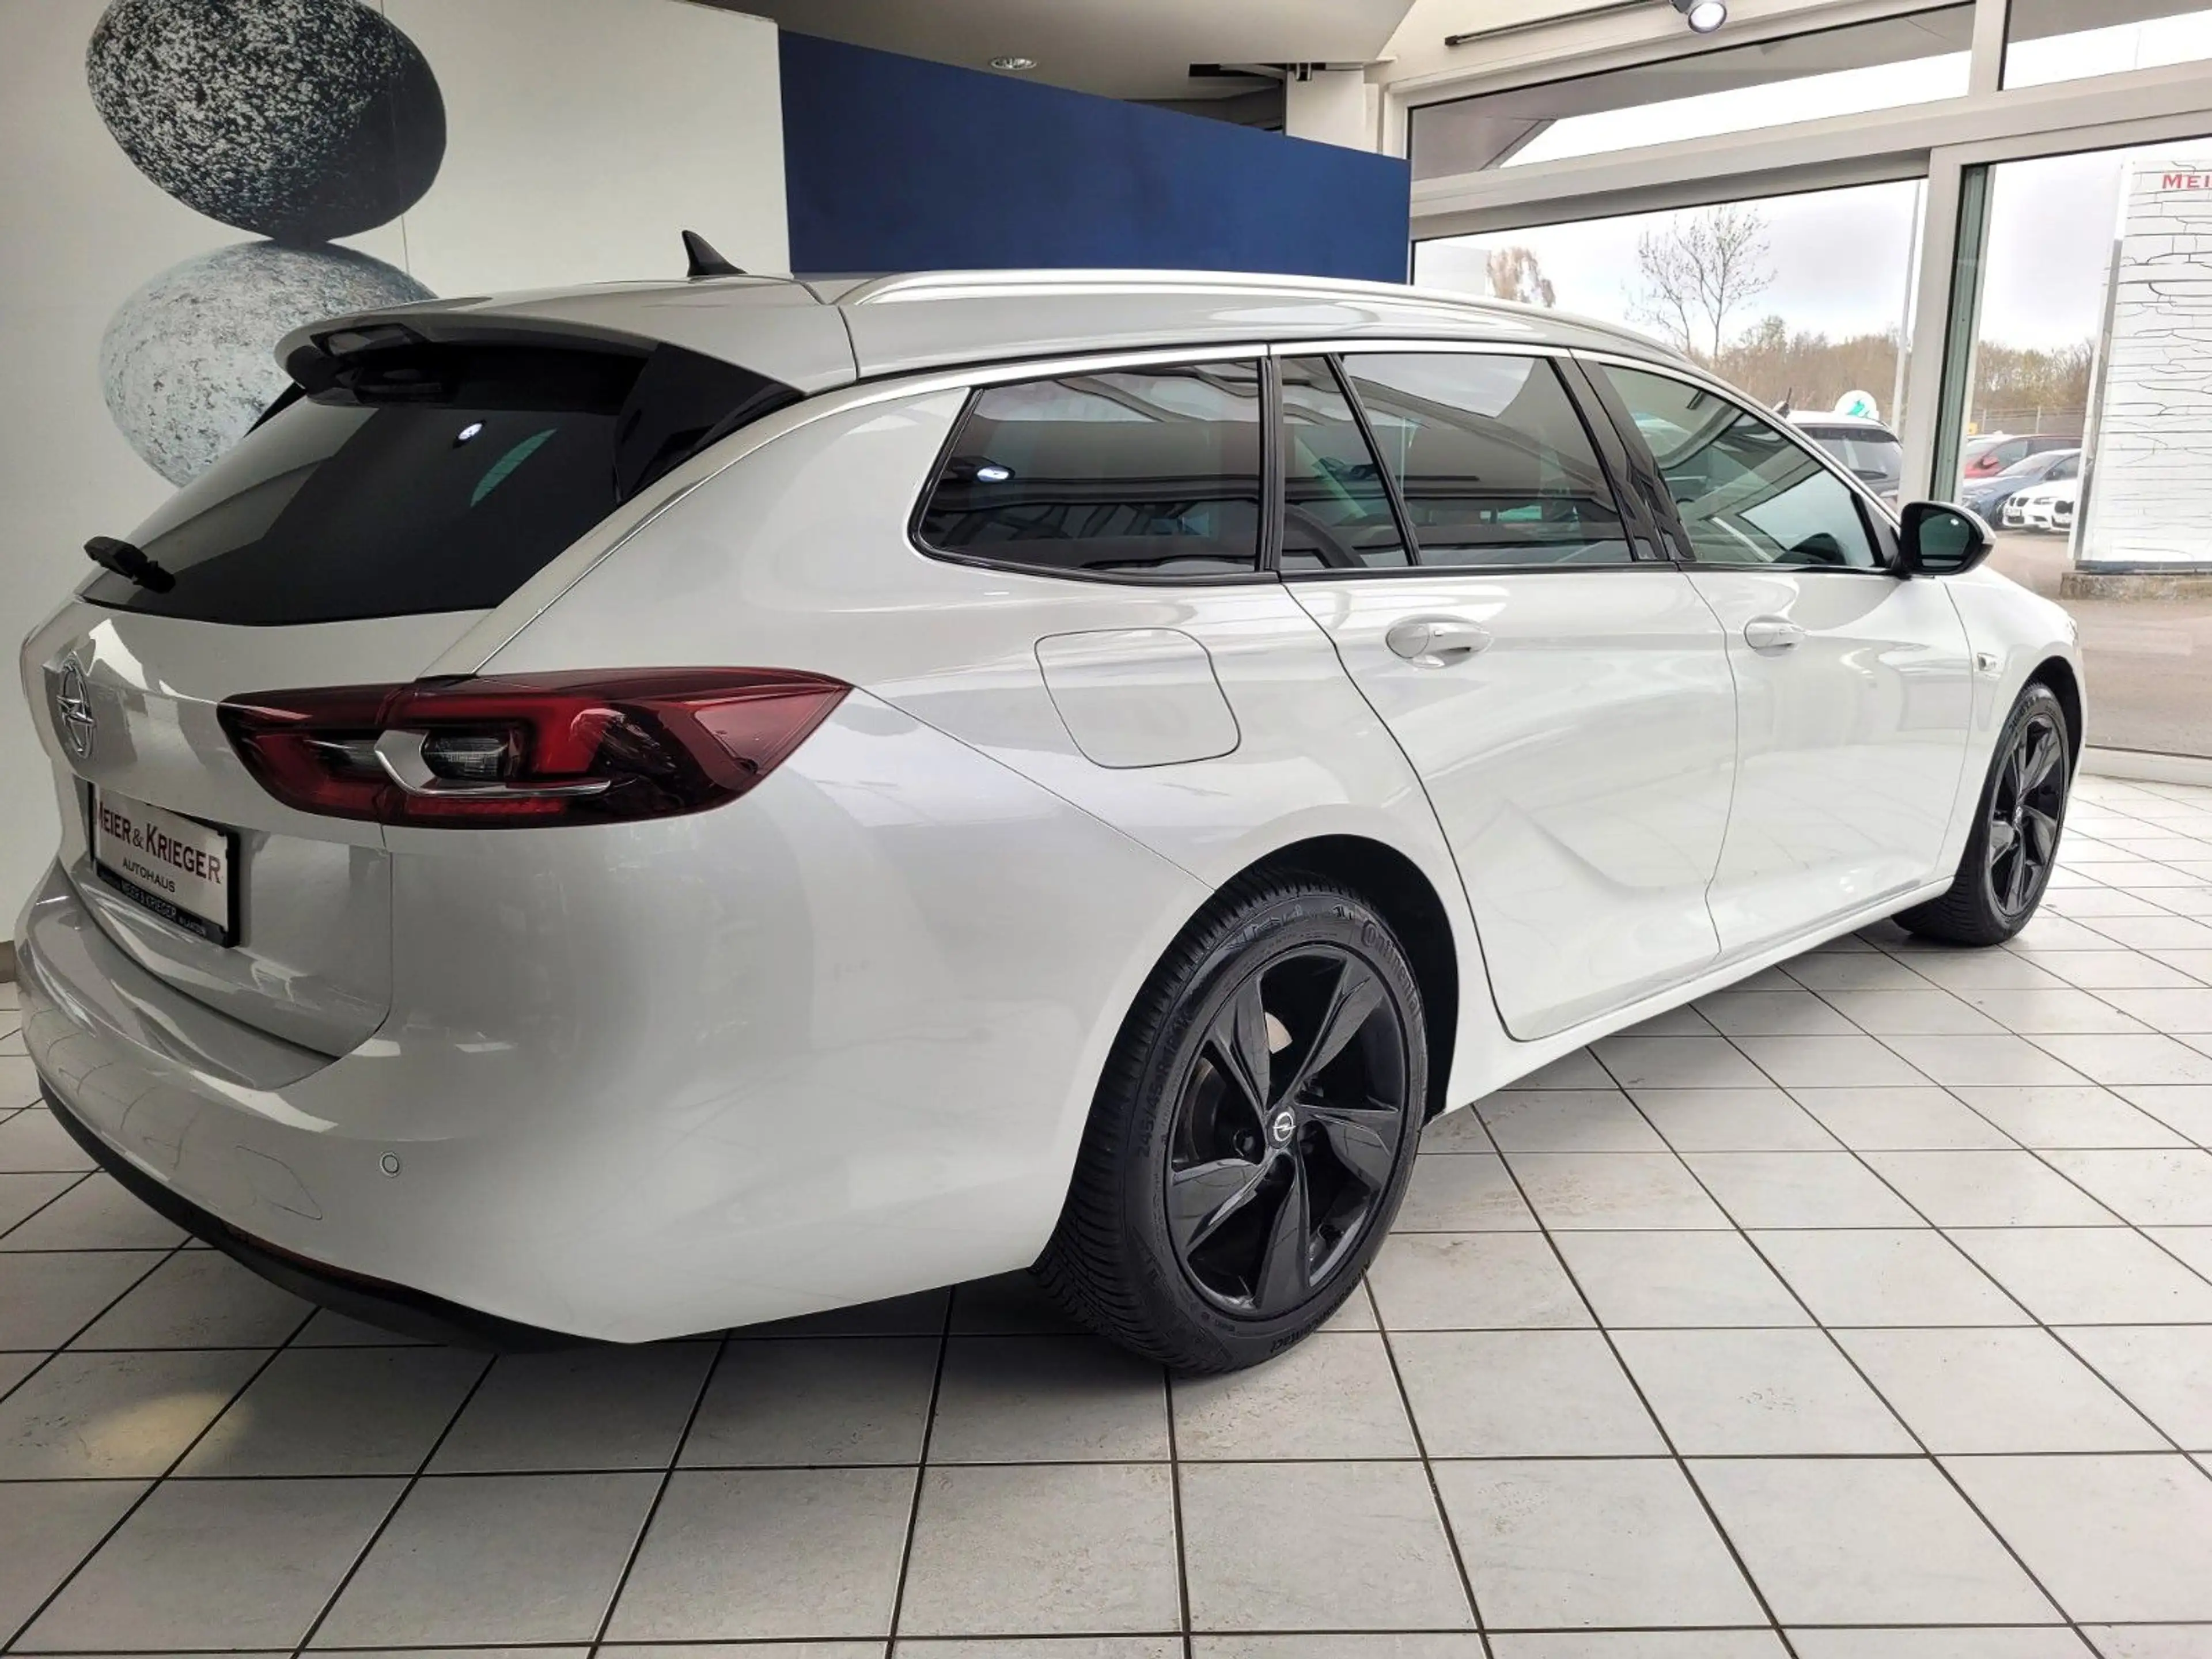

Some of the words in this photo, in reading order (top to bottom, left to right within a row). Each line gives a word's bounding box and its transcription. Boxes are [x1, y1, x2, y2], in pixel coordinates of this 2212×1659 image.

[2162, 173, 2210, 189] MEI
[146, 823, 222, 884] KRIEGER
[122, 857, 176, 893] AUTOHAUS
